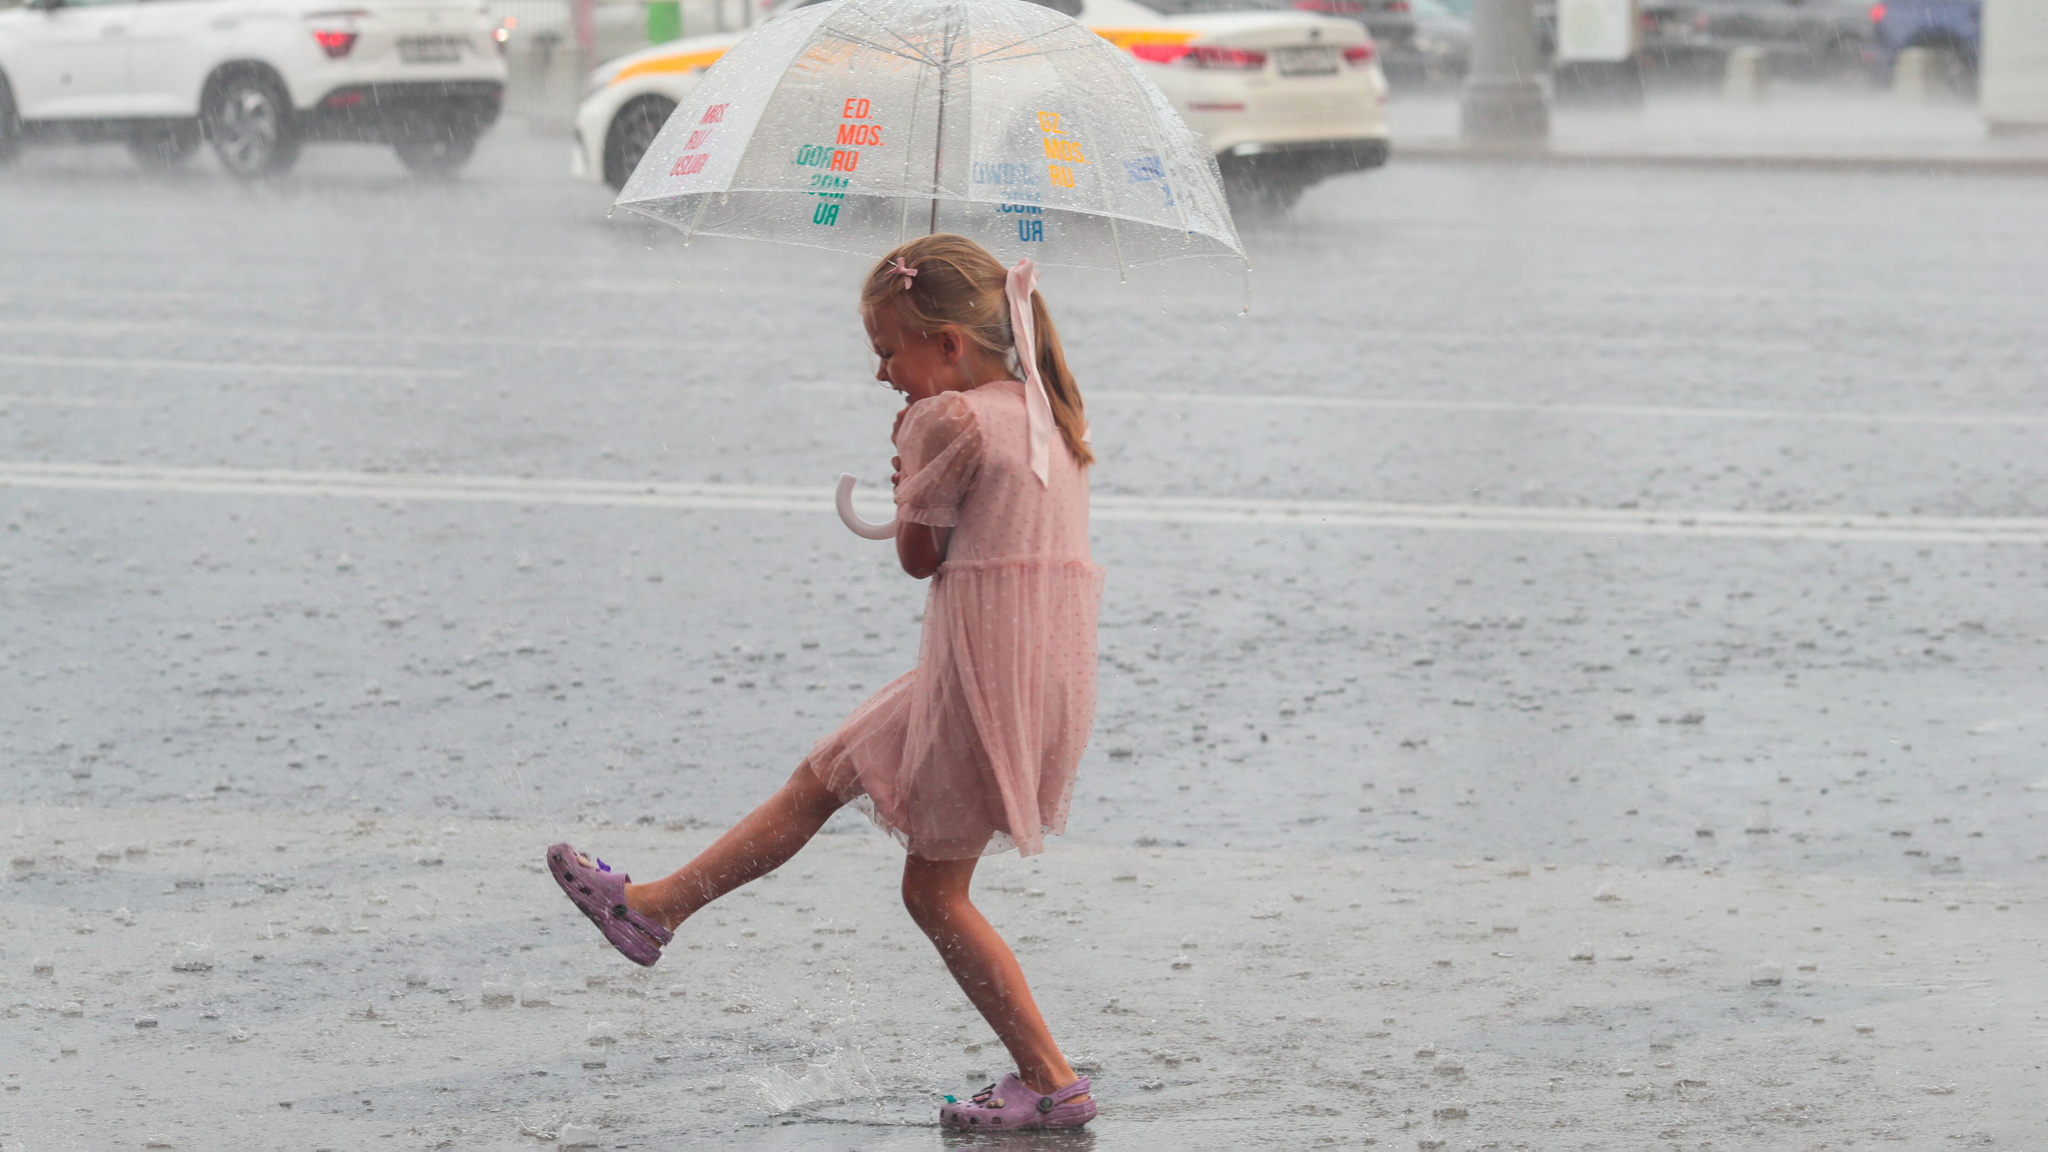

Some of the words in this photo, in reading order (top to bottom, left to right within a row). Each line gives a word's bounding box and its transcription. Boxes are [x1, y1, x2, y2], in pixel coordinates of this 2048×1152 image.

[842, 98, 873, 119] ED.
[1038, 111, 1069, 135] GZ.
[836, 124, 885, 146] MOS.
[830, 150, 860, 172] RU
[1043, 137, 1091, 165] MOS.
[1048, 164, 1075, 188] RU
